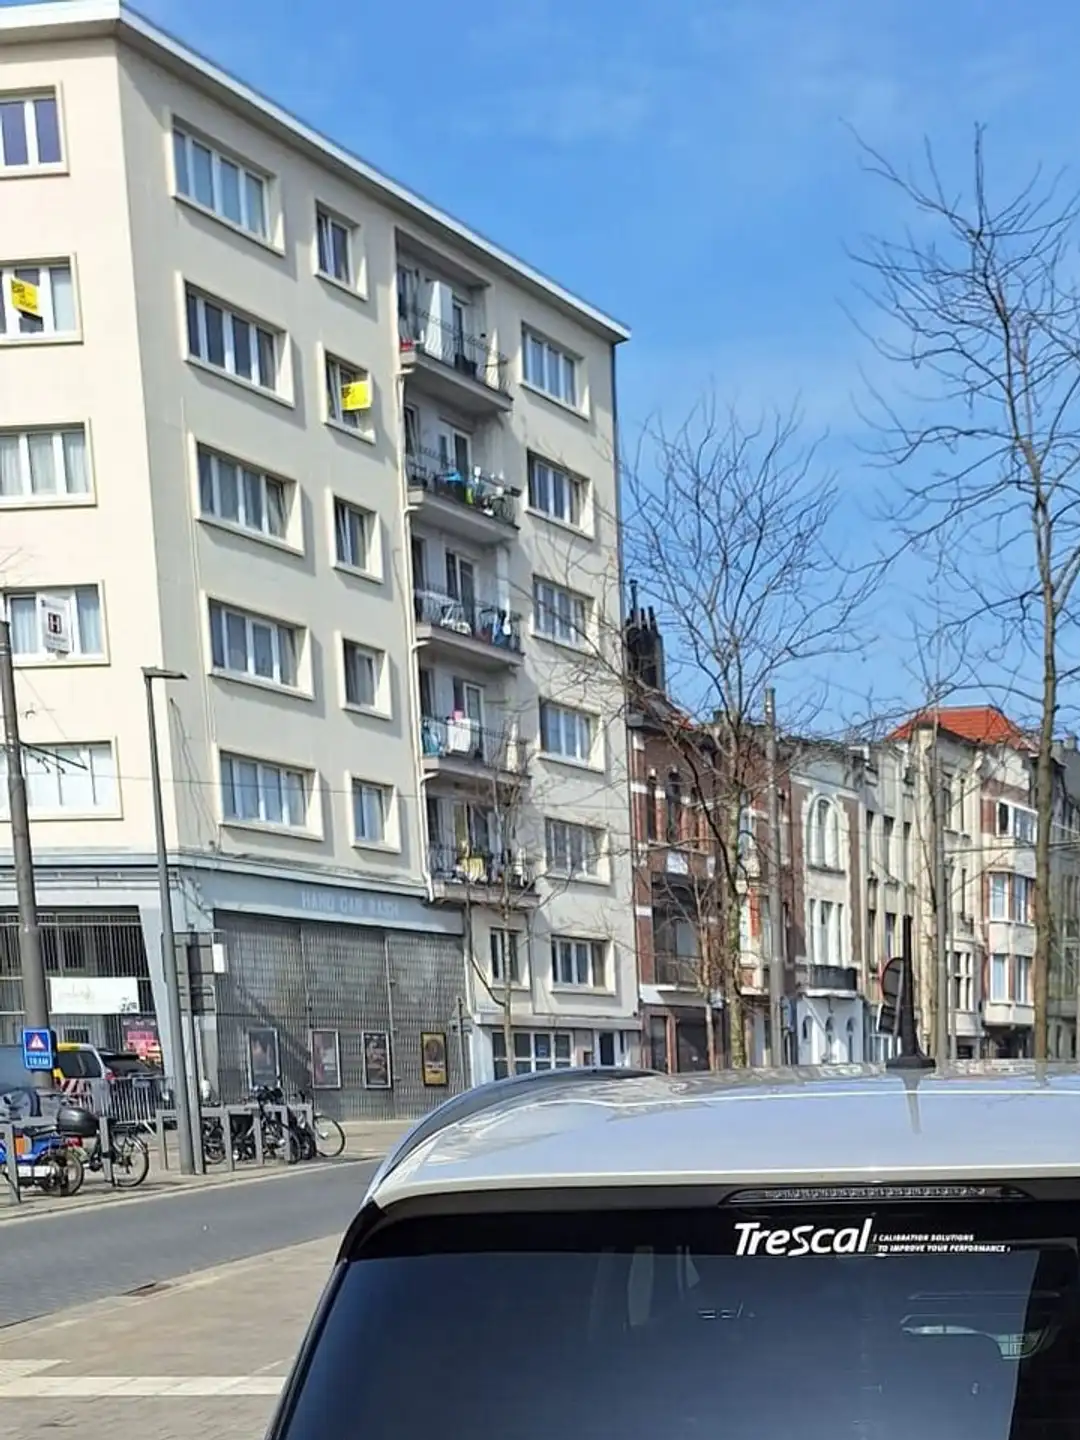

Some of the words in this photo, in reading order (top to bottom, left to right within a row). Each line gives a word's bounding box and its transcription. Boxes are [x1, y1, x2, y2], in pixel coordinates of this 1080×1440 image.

[879, 1233, 929, 1242] CALIBRATION
[931, 1233, 974, 1242] SOLUTIONS
[878, 1244, 889, 1253] TO
[890, 1244, 925, 1253] IMPROVE
[927, 1244, 948, 1253] YOUR
[949, 1244, 1006, 1253] PERFORMANCE
